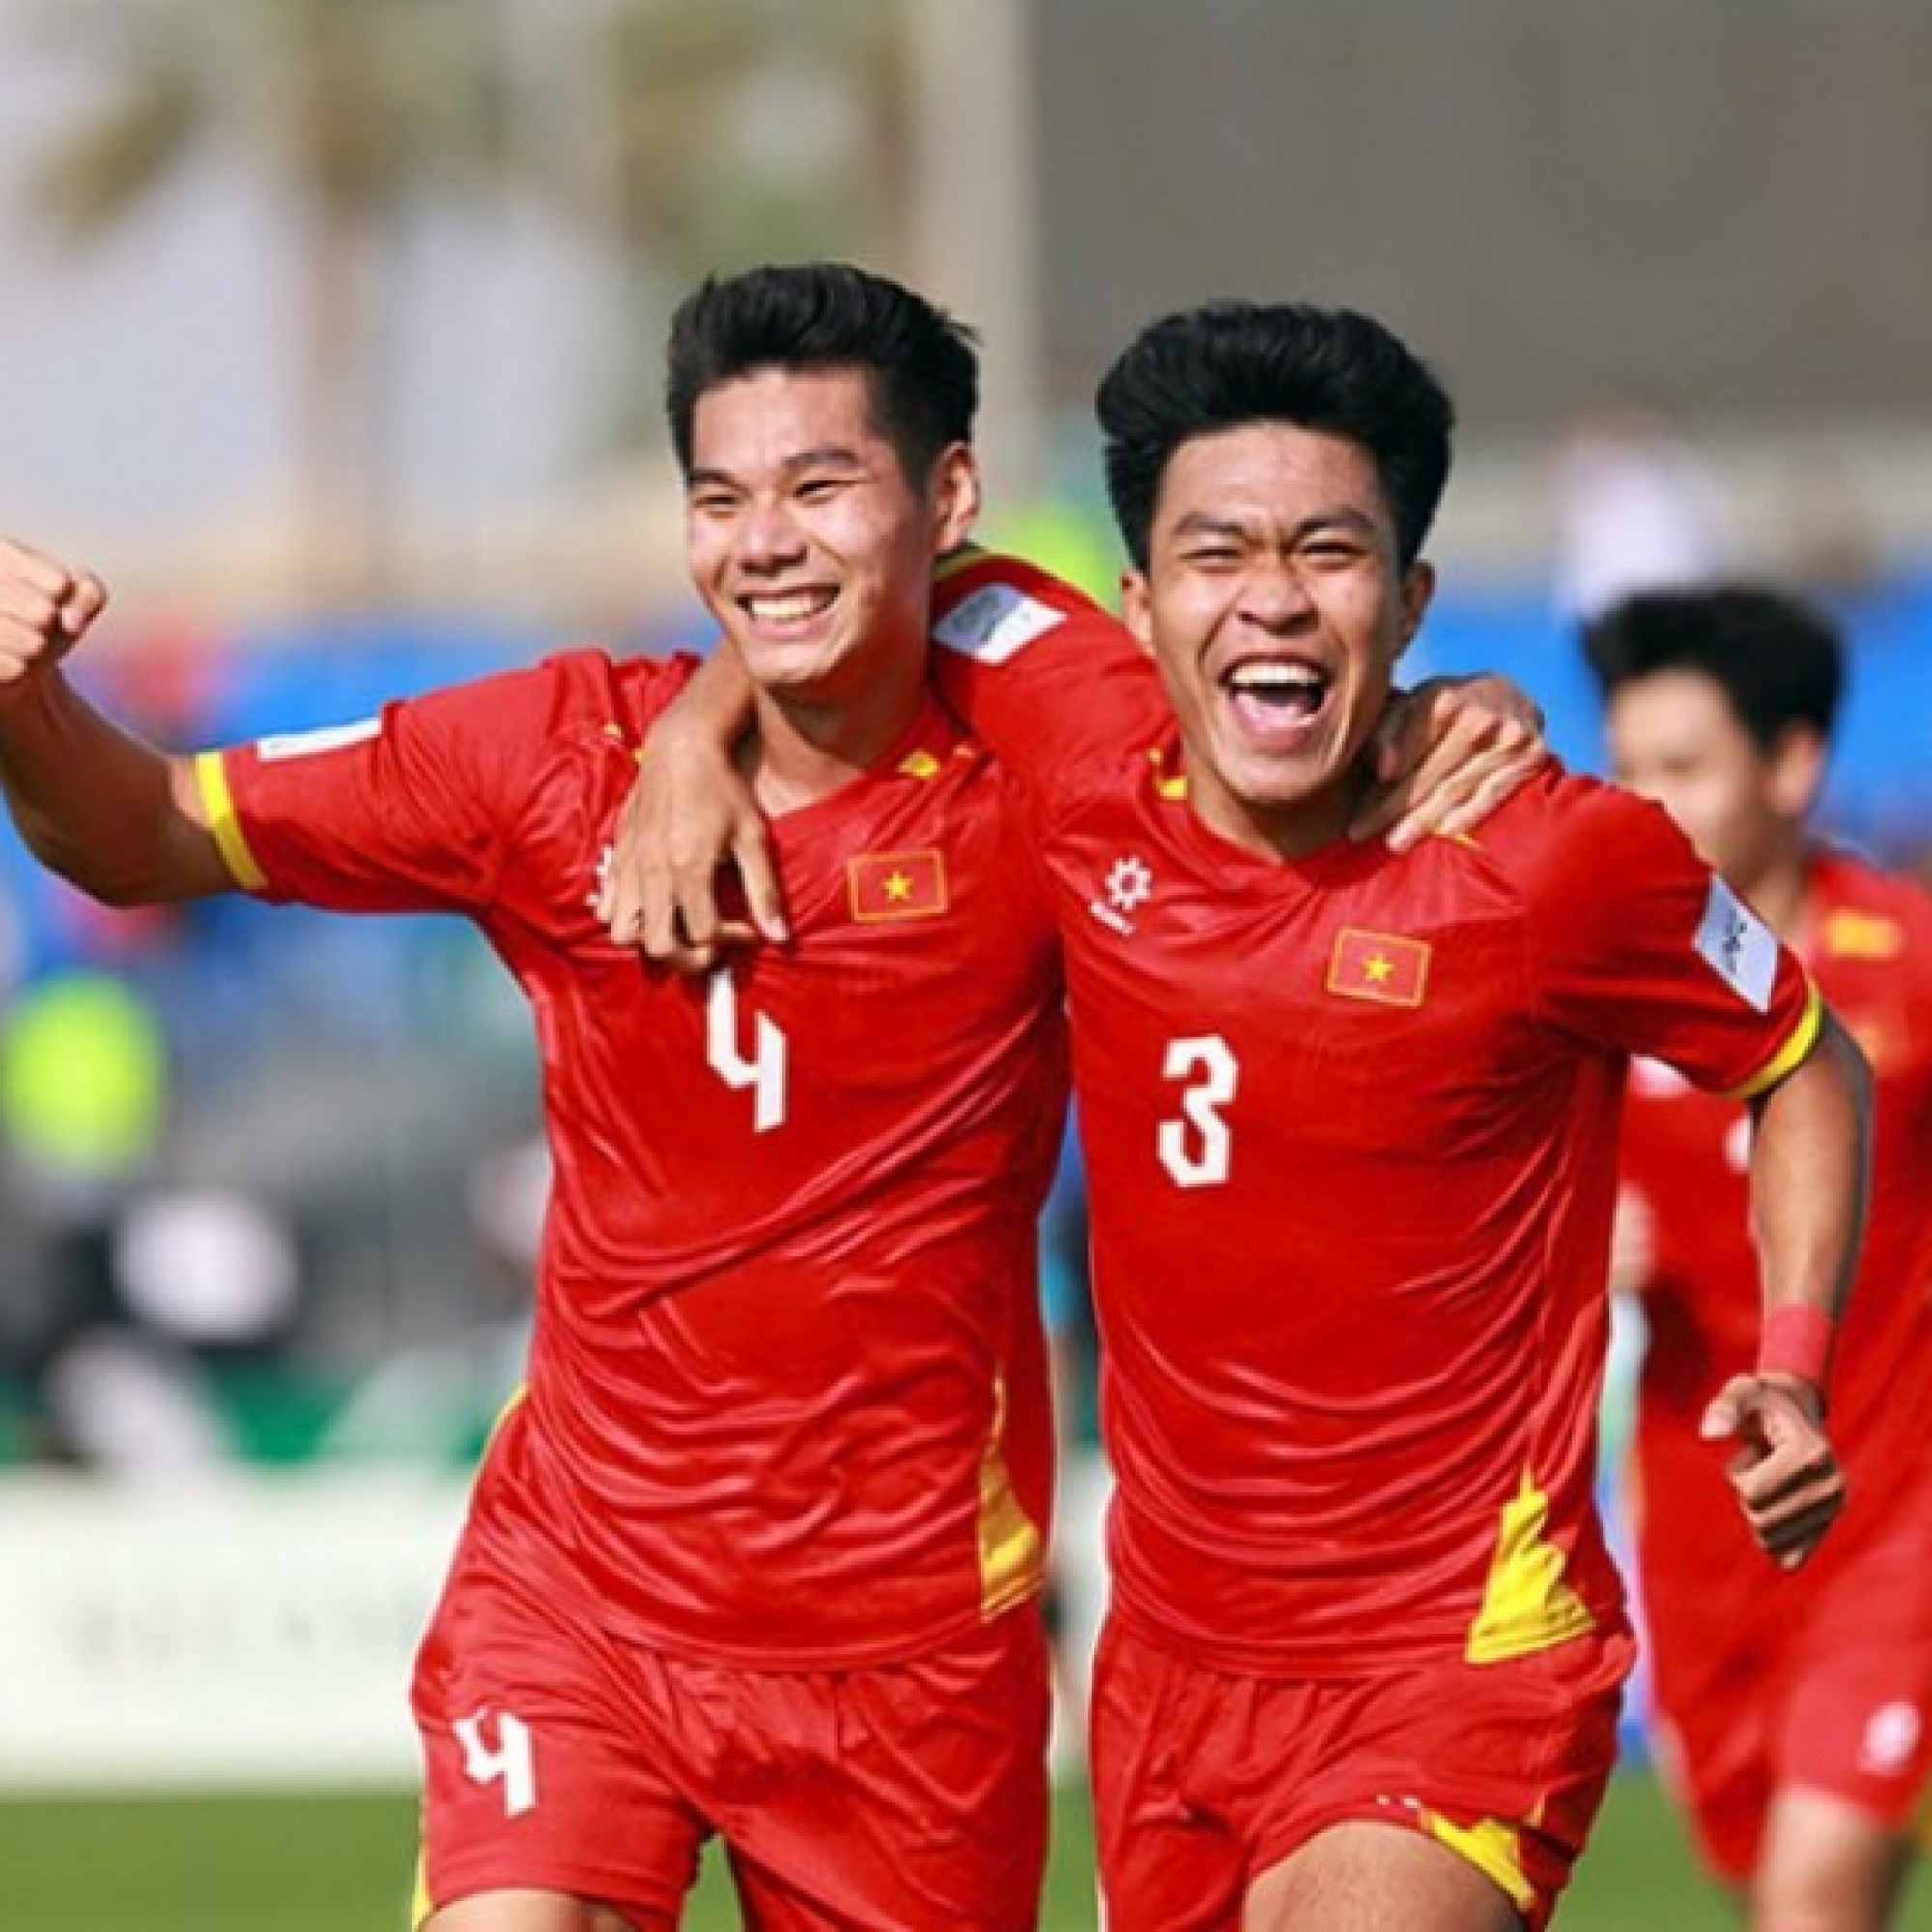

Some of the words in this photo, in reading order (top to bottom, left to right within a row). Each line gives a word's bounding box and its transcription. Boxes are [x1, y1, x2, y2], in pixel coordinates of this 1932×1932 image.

[706, 968, 787, 1131] 4
[1157, 1035, 1238, 1187] 3
[452, 1706, 536, 1816] 4
